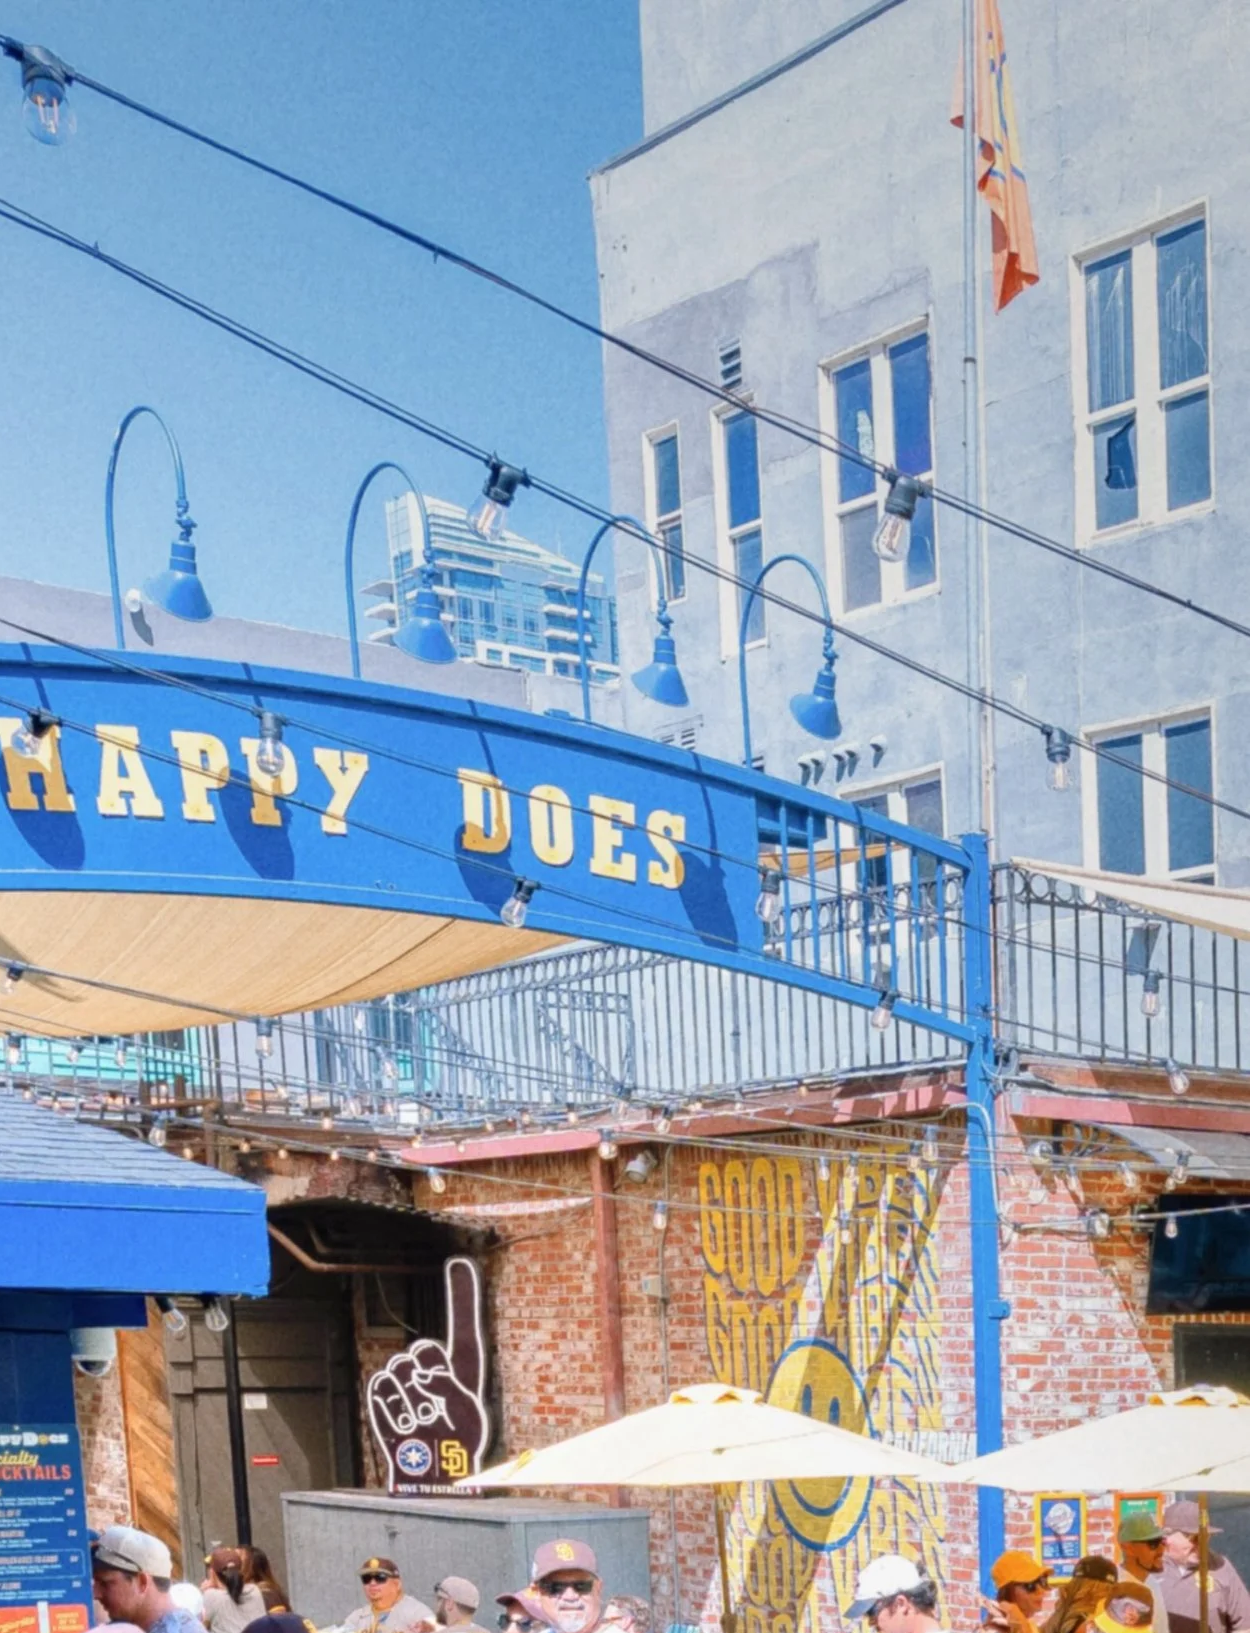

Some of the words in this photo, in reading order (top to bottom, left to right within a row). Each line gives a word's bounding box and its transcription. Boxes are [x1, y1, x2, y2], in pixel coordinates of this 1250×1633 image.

[457, 767, 686, 890] DOES
[699, 1156, 805, 1298] GOOD
[441, 1440, 468, 1477] SD
